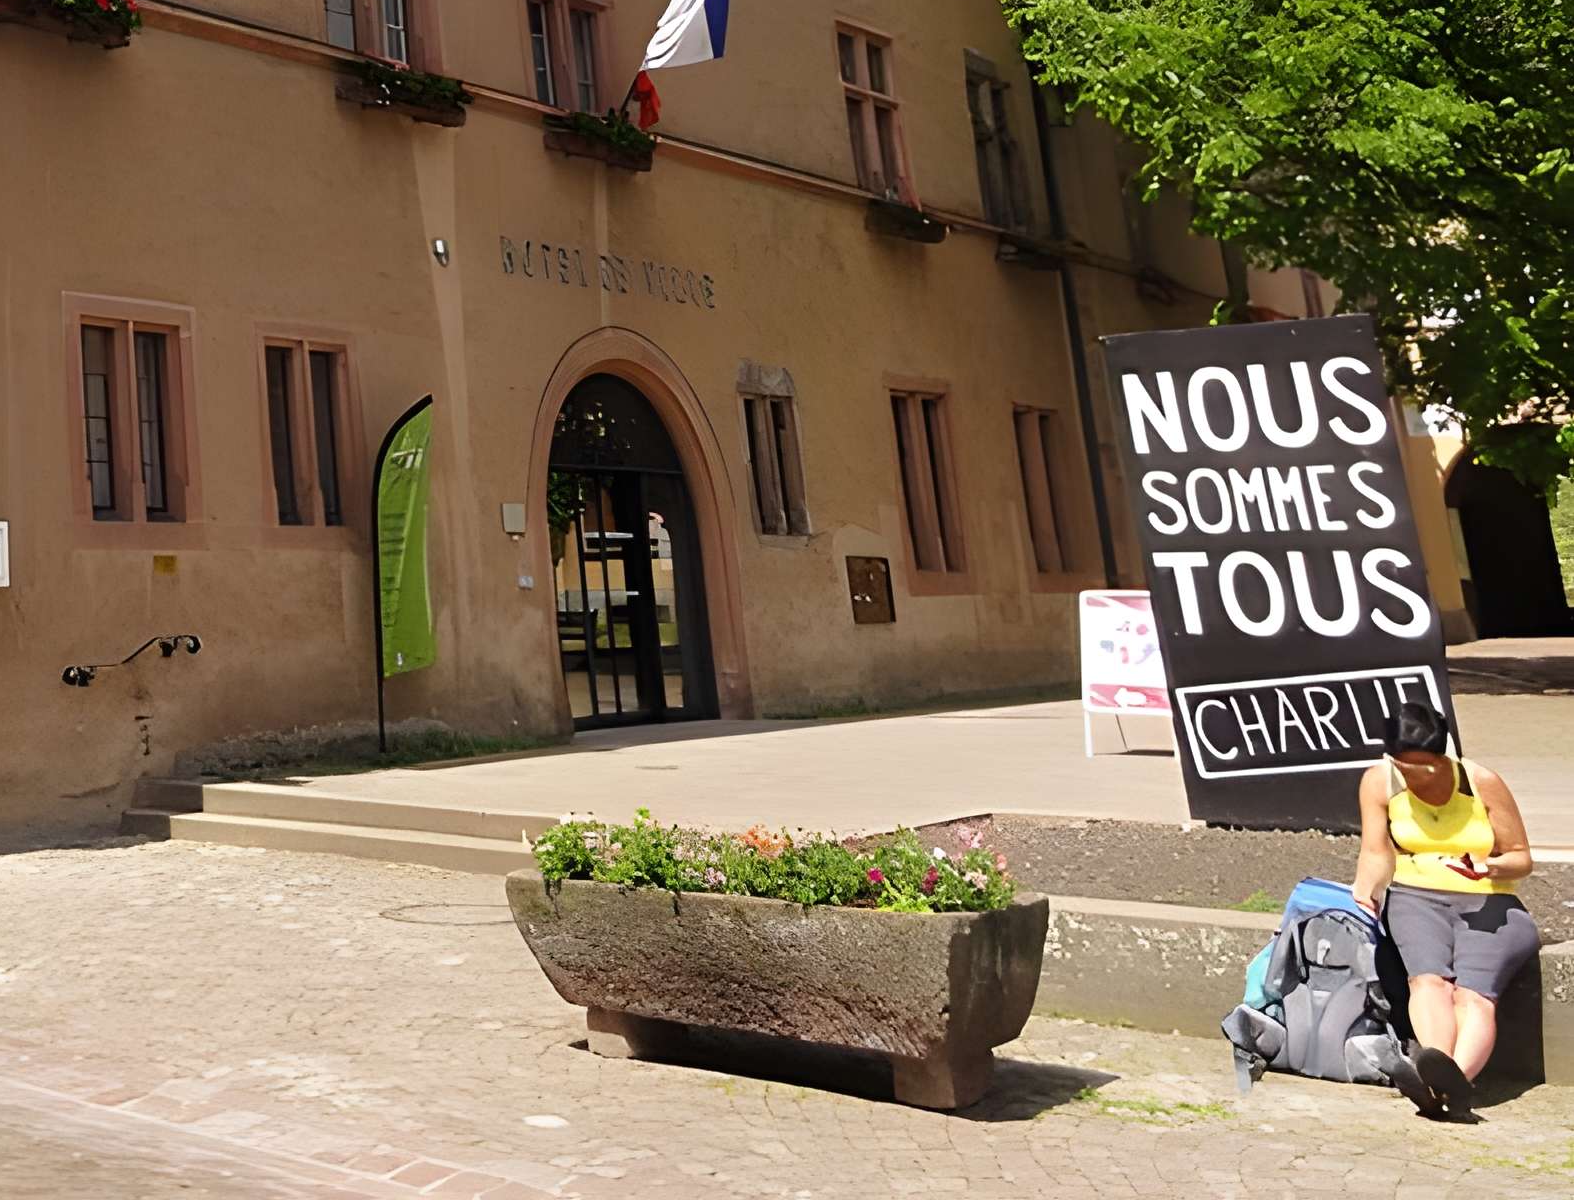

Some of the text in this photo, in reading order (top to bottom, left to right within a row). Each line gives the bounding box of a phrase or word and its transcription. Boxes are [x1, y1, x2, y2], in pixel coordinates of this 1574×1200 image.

[1121, 357, 1387, 455] NOUS
[1140, 460, 1398, 536] SOMMES
[1152, 548, 1432, 639] TOUS
